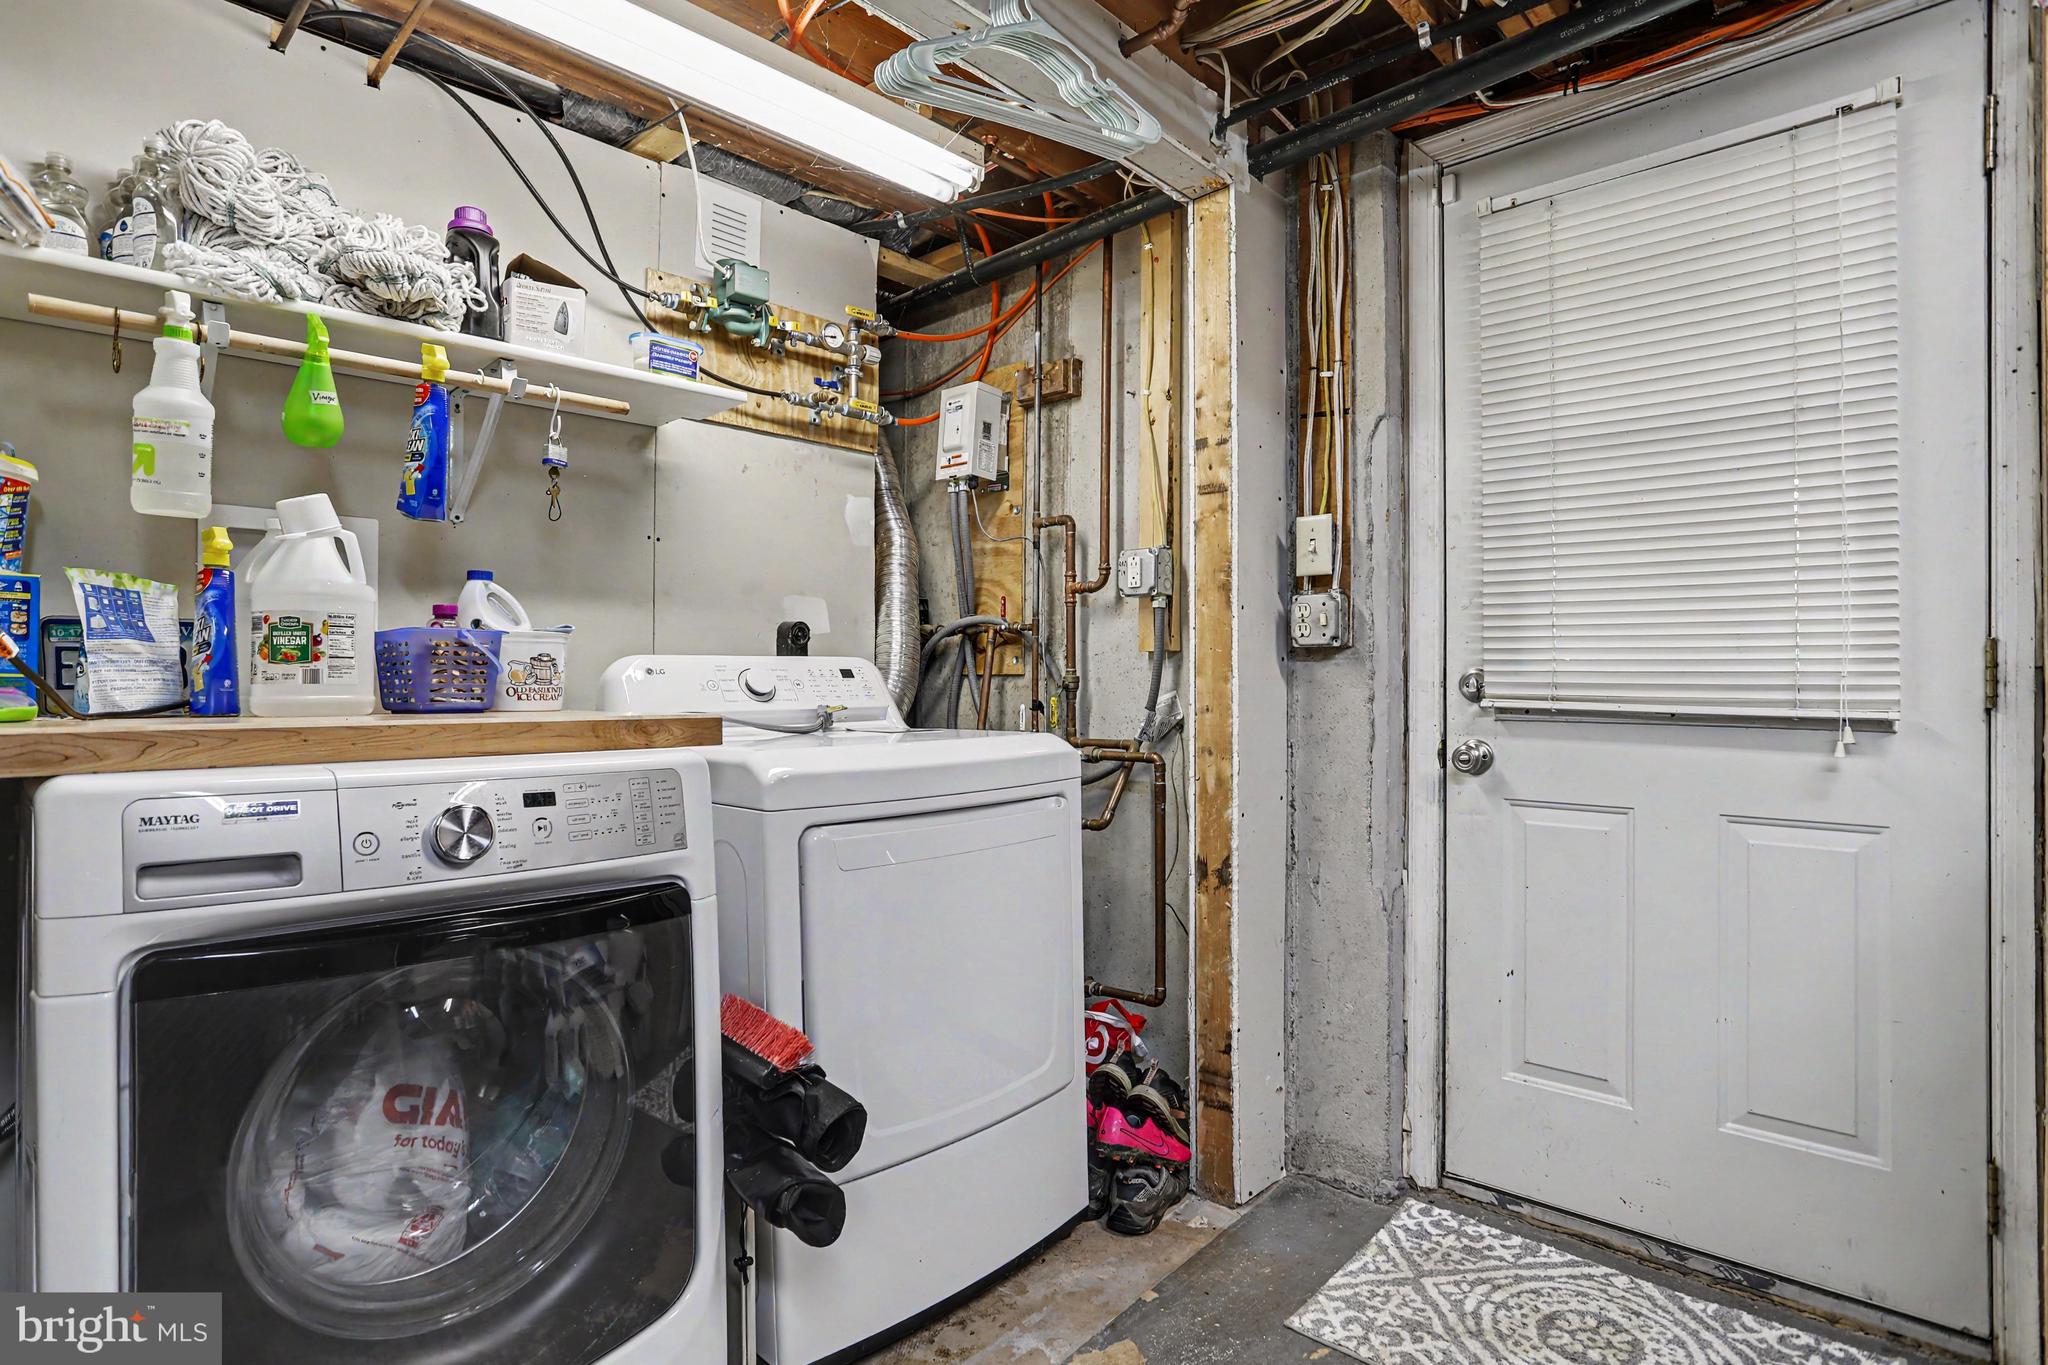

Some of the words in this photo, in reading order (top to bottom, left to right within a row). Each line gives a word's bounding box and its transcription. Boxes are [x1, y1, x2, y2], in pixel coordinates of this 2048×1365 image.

[272, 637, 307, 645] VINEGAR
[266, 804, 298, 813] DRIVE
[138, 814, 200, 827] MAYTAG
[382, 1083, 463, 1129] GIA
[394, 1134, 418, 1150] for
